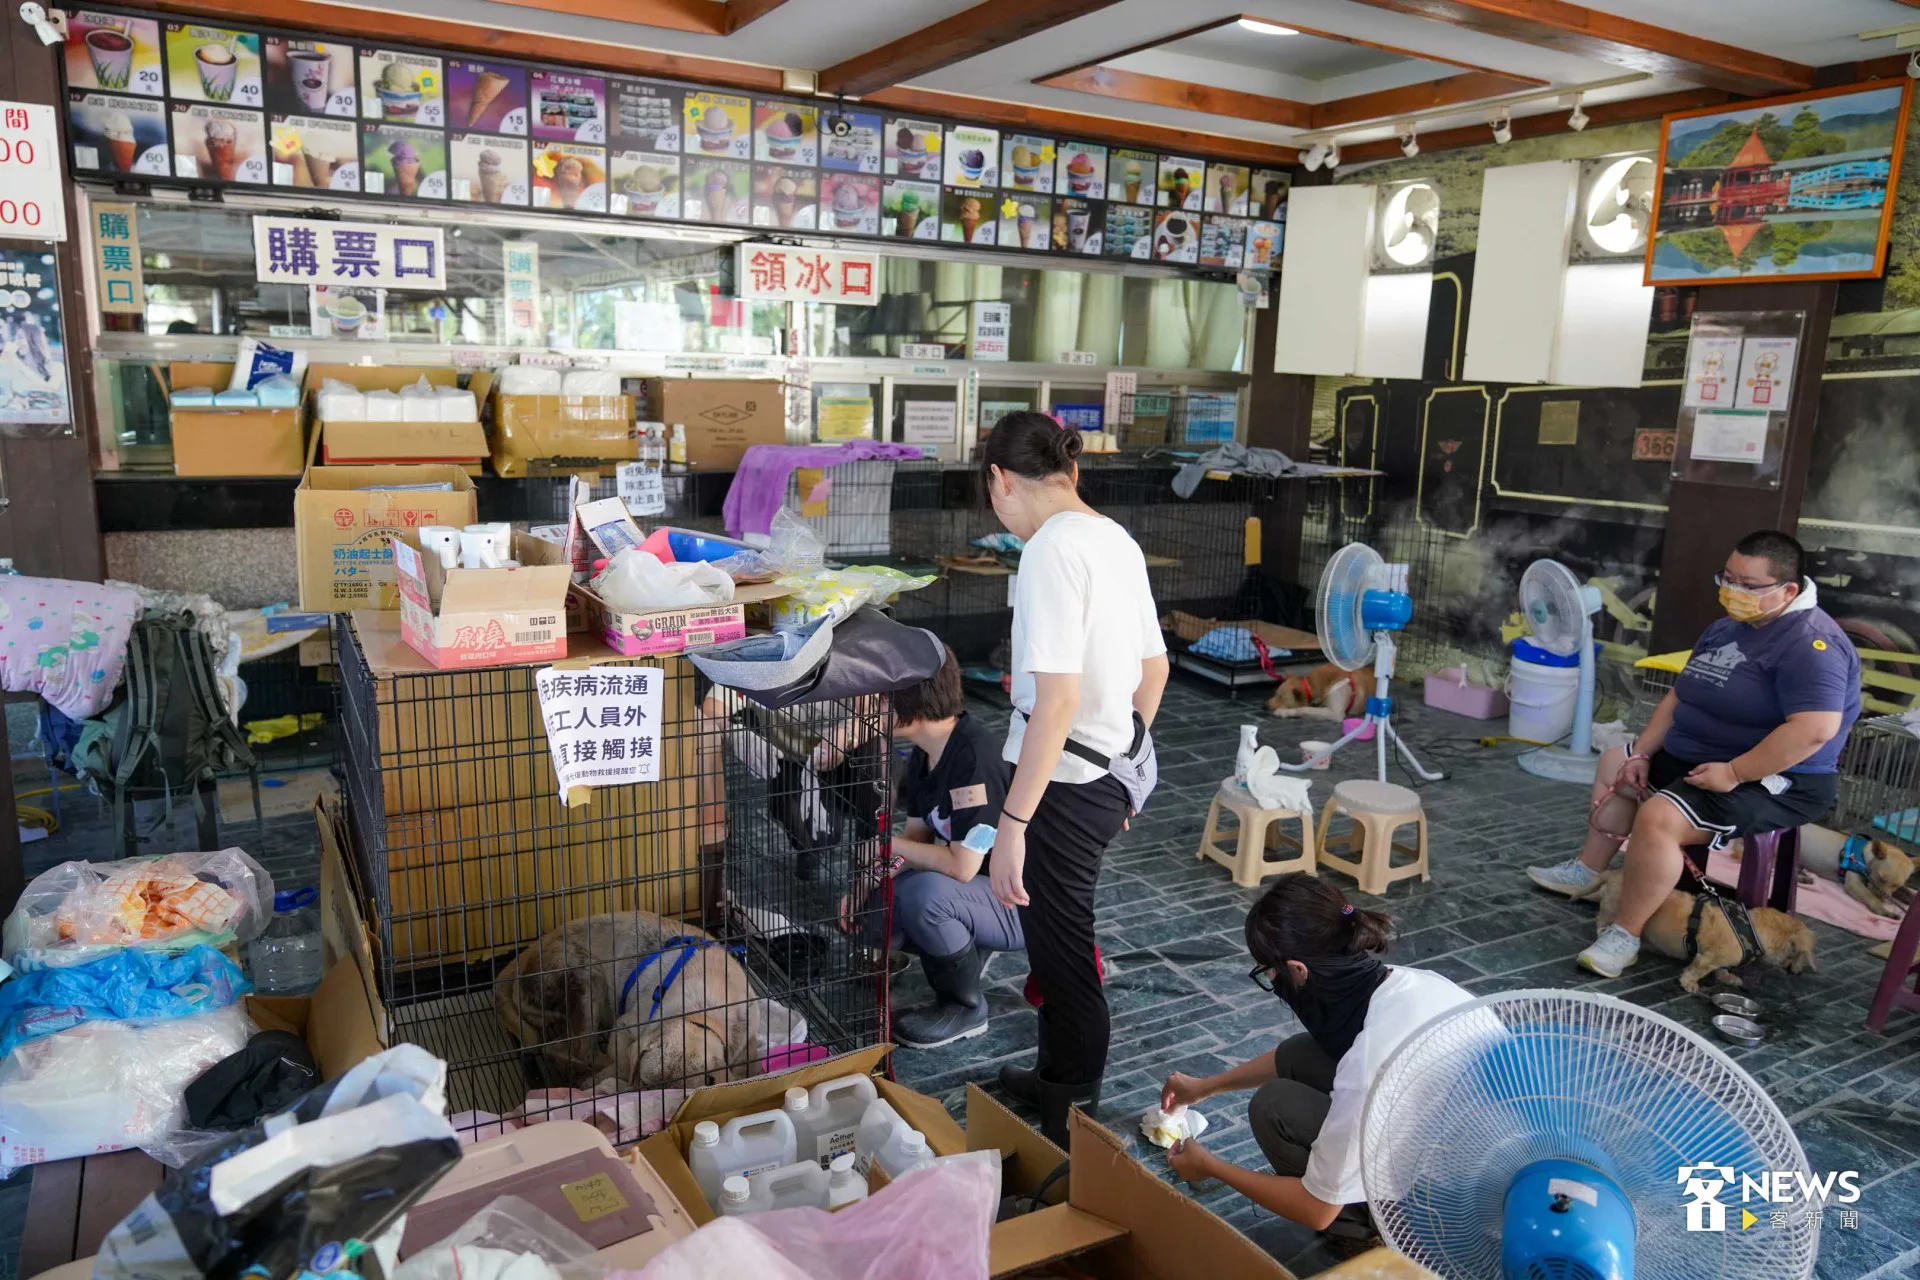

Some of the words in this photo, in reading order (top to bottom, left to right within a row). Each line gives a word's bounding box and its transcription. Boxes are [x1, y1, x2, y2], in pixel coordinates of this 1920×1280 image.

[139, 71, 158, 82] 20
[240, 85, 259, 95] 40
[335, 95, 353, 106] 30
[175, 104, 187, 112] 20
[424, 105, 440, 116] 55
[5, 109, 29, 130] 間
[509, 116, 523, 124] 15
[588, 123, 602, 133] 20
[664, 133, 677, 142] 30
[146, 152, 163, 163] 60
[802, 148, 814, 157] 55
[866, 156, 878, 164] 12
[246, 161, 263, 171] 60
[926, 164, 938, 172] 60
[340, 171, 356, 181] 55
[984, 170, 995, 178] 60
[427, 178, 443, 188] 55
[511, 184, 526, 194] 55
[925, 222, 936, 230] 55
[982, 227, 992, 235] 55
[268, 227, 436, 278] 購票口
[98, 212, 133, 304] 購票口
[750, 250, 872, 296] 領冰口
[508, 250, 533, 328] 購票口
[334, 566, 369, 577] バター
[655, 615, 687, 629] GRAIN
[450, 618, 506, 651] 原燒
[661, 627, 682, 638] FREE
[830, 1132, 855, 1144] Aether
